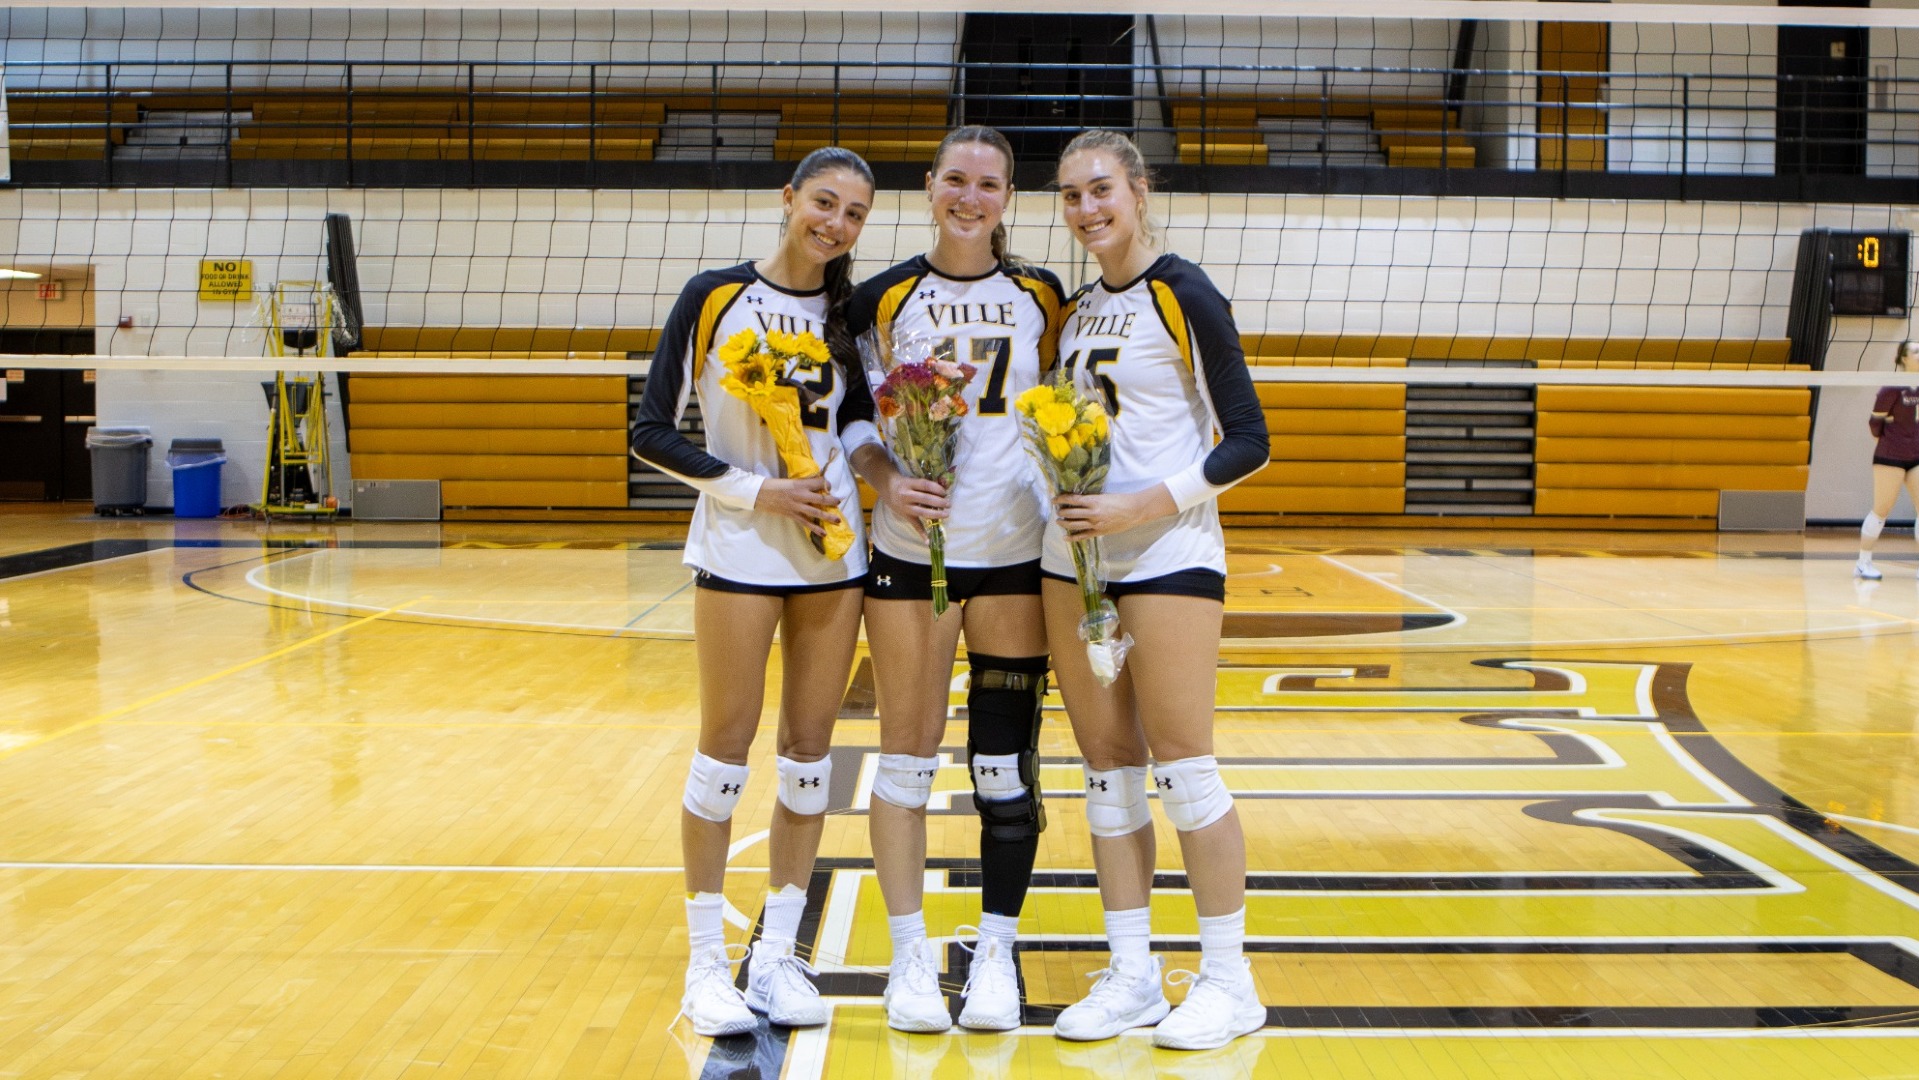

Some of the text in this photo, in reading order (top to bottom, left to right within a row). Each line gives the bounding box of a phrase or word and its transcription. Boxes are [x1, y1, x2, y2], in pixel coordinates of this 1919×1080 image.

[213, 262, 236, 272] NO
[39, 283, 56, 299] EXIT
[753, 310, 826, 336] VILL
[927, 301, 1017, 331] VILLE
[1075, 313, 1137, 347] VILLE
